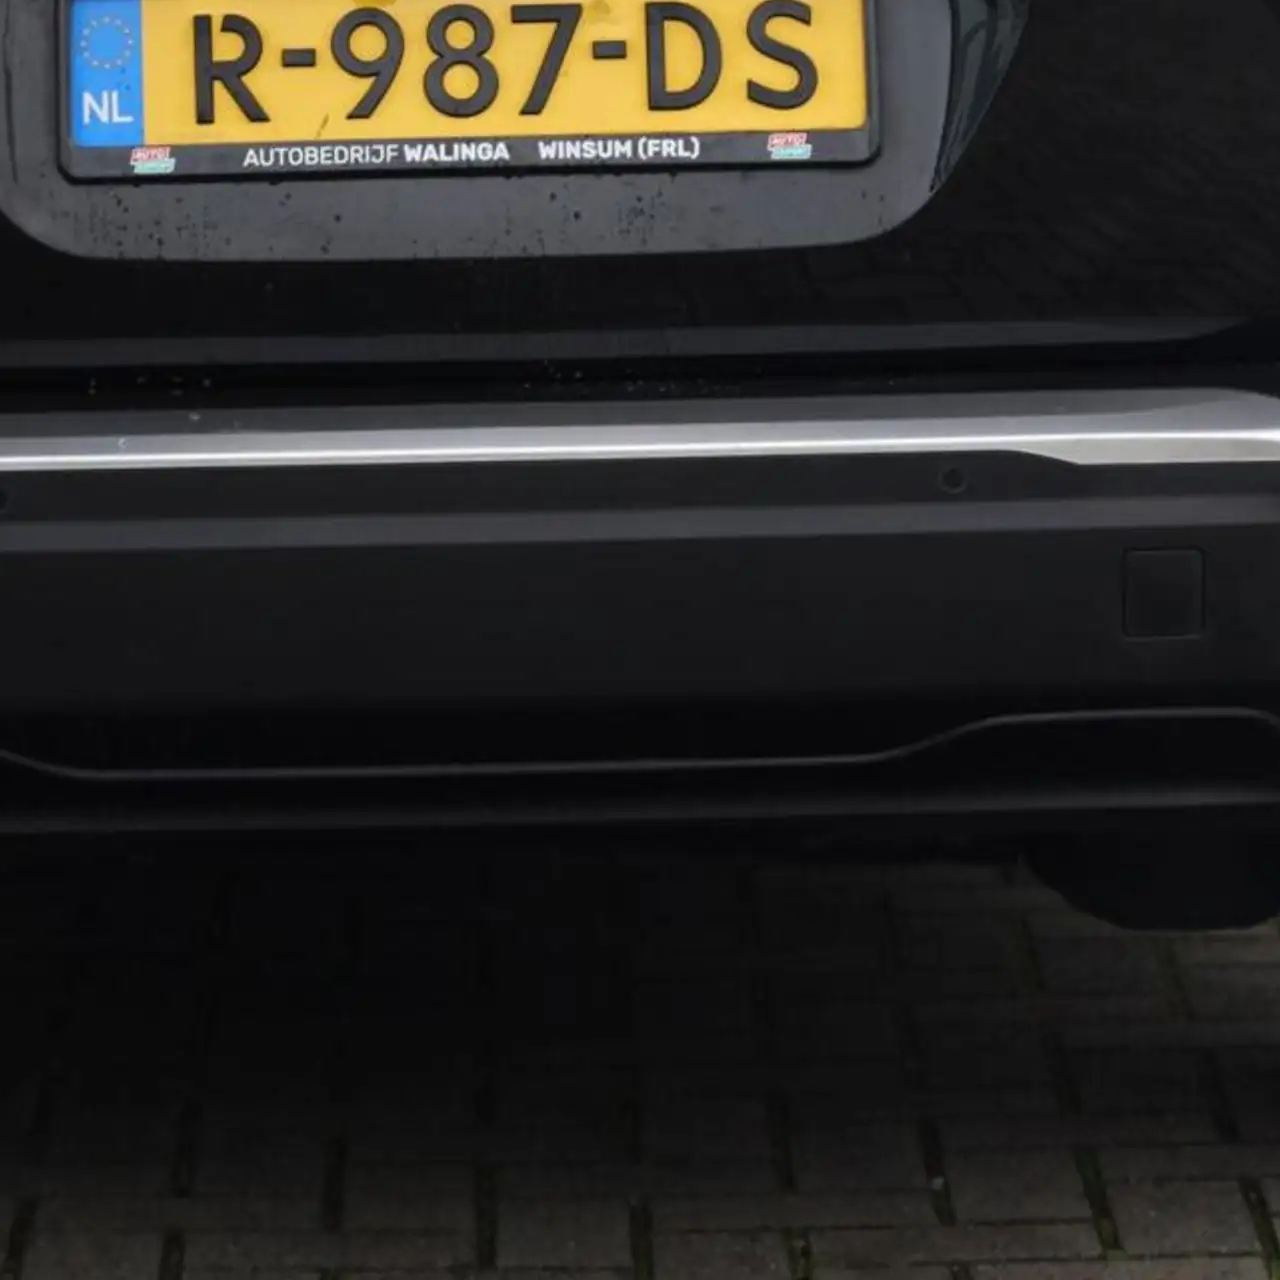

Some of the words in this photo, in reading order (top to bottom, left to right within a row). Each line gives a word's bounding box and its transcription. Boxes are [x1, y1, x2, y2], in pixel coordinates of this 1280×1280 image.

[82, 89, 135, 124] NL
[243, 144, 400, 168] AUTOBEDRIJF
[403, 142, 510, 163] WALINGA
[538, 138, 633, 161] WINSUM
[637, 136, 701, 160] (FRL)
